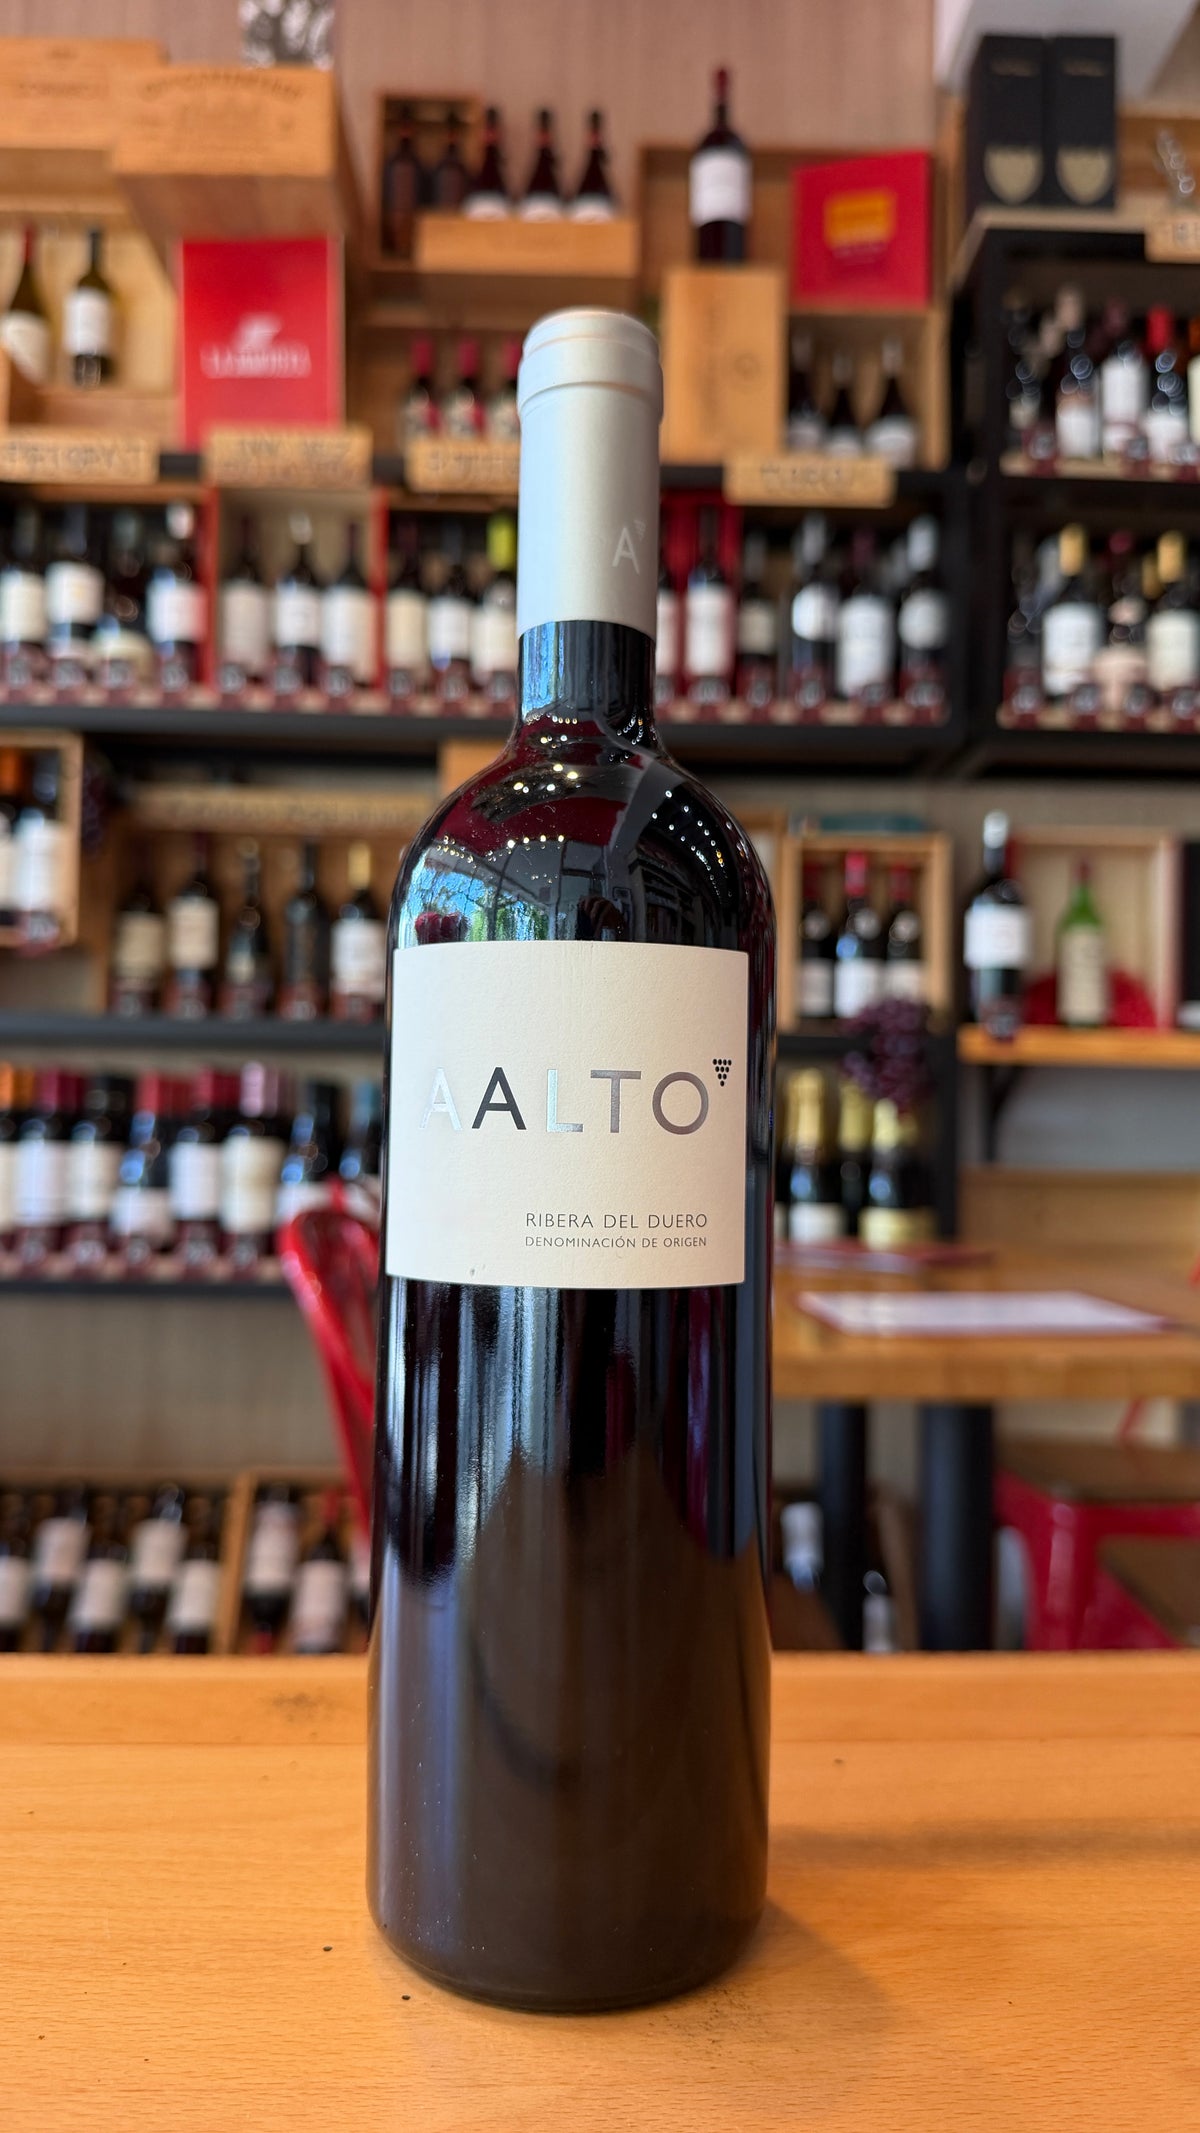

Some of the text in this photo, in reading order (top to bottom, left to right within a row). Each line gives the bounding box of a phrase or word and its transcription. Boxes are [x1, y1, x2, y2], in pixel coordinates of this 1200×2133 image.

[611, 527, 640, 576] A
[418, 1066, 710, 1136] AALTO
[525, 1212, 708, 1229] RIBERA DEL DUERO
[525, 1235, 707, 1249] DENOMINACIÓN DE ORIGEN
